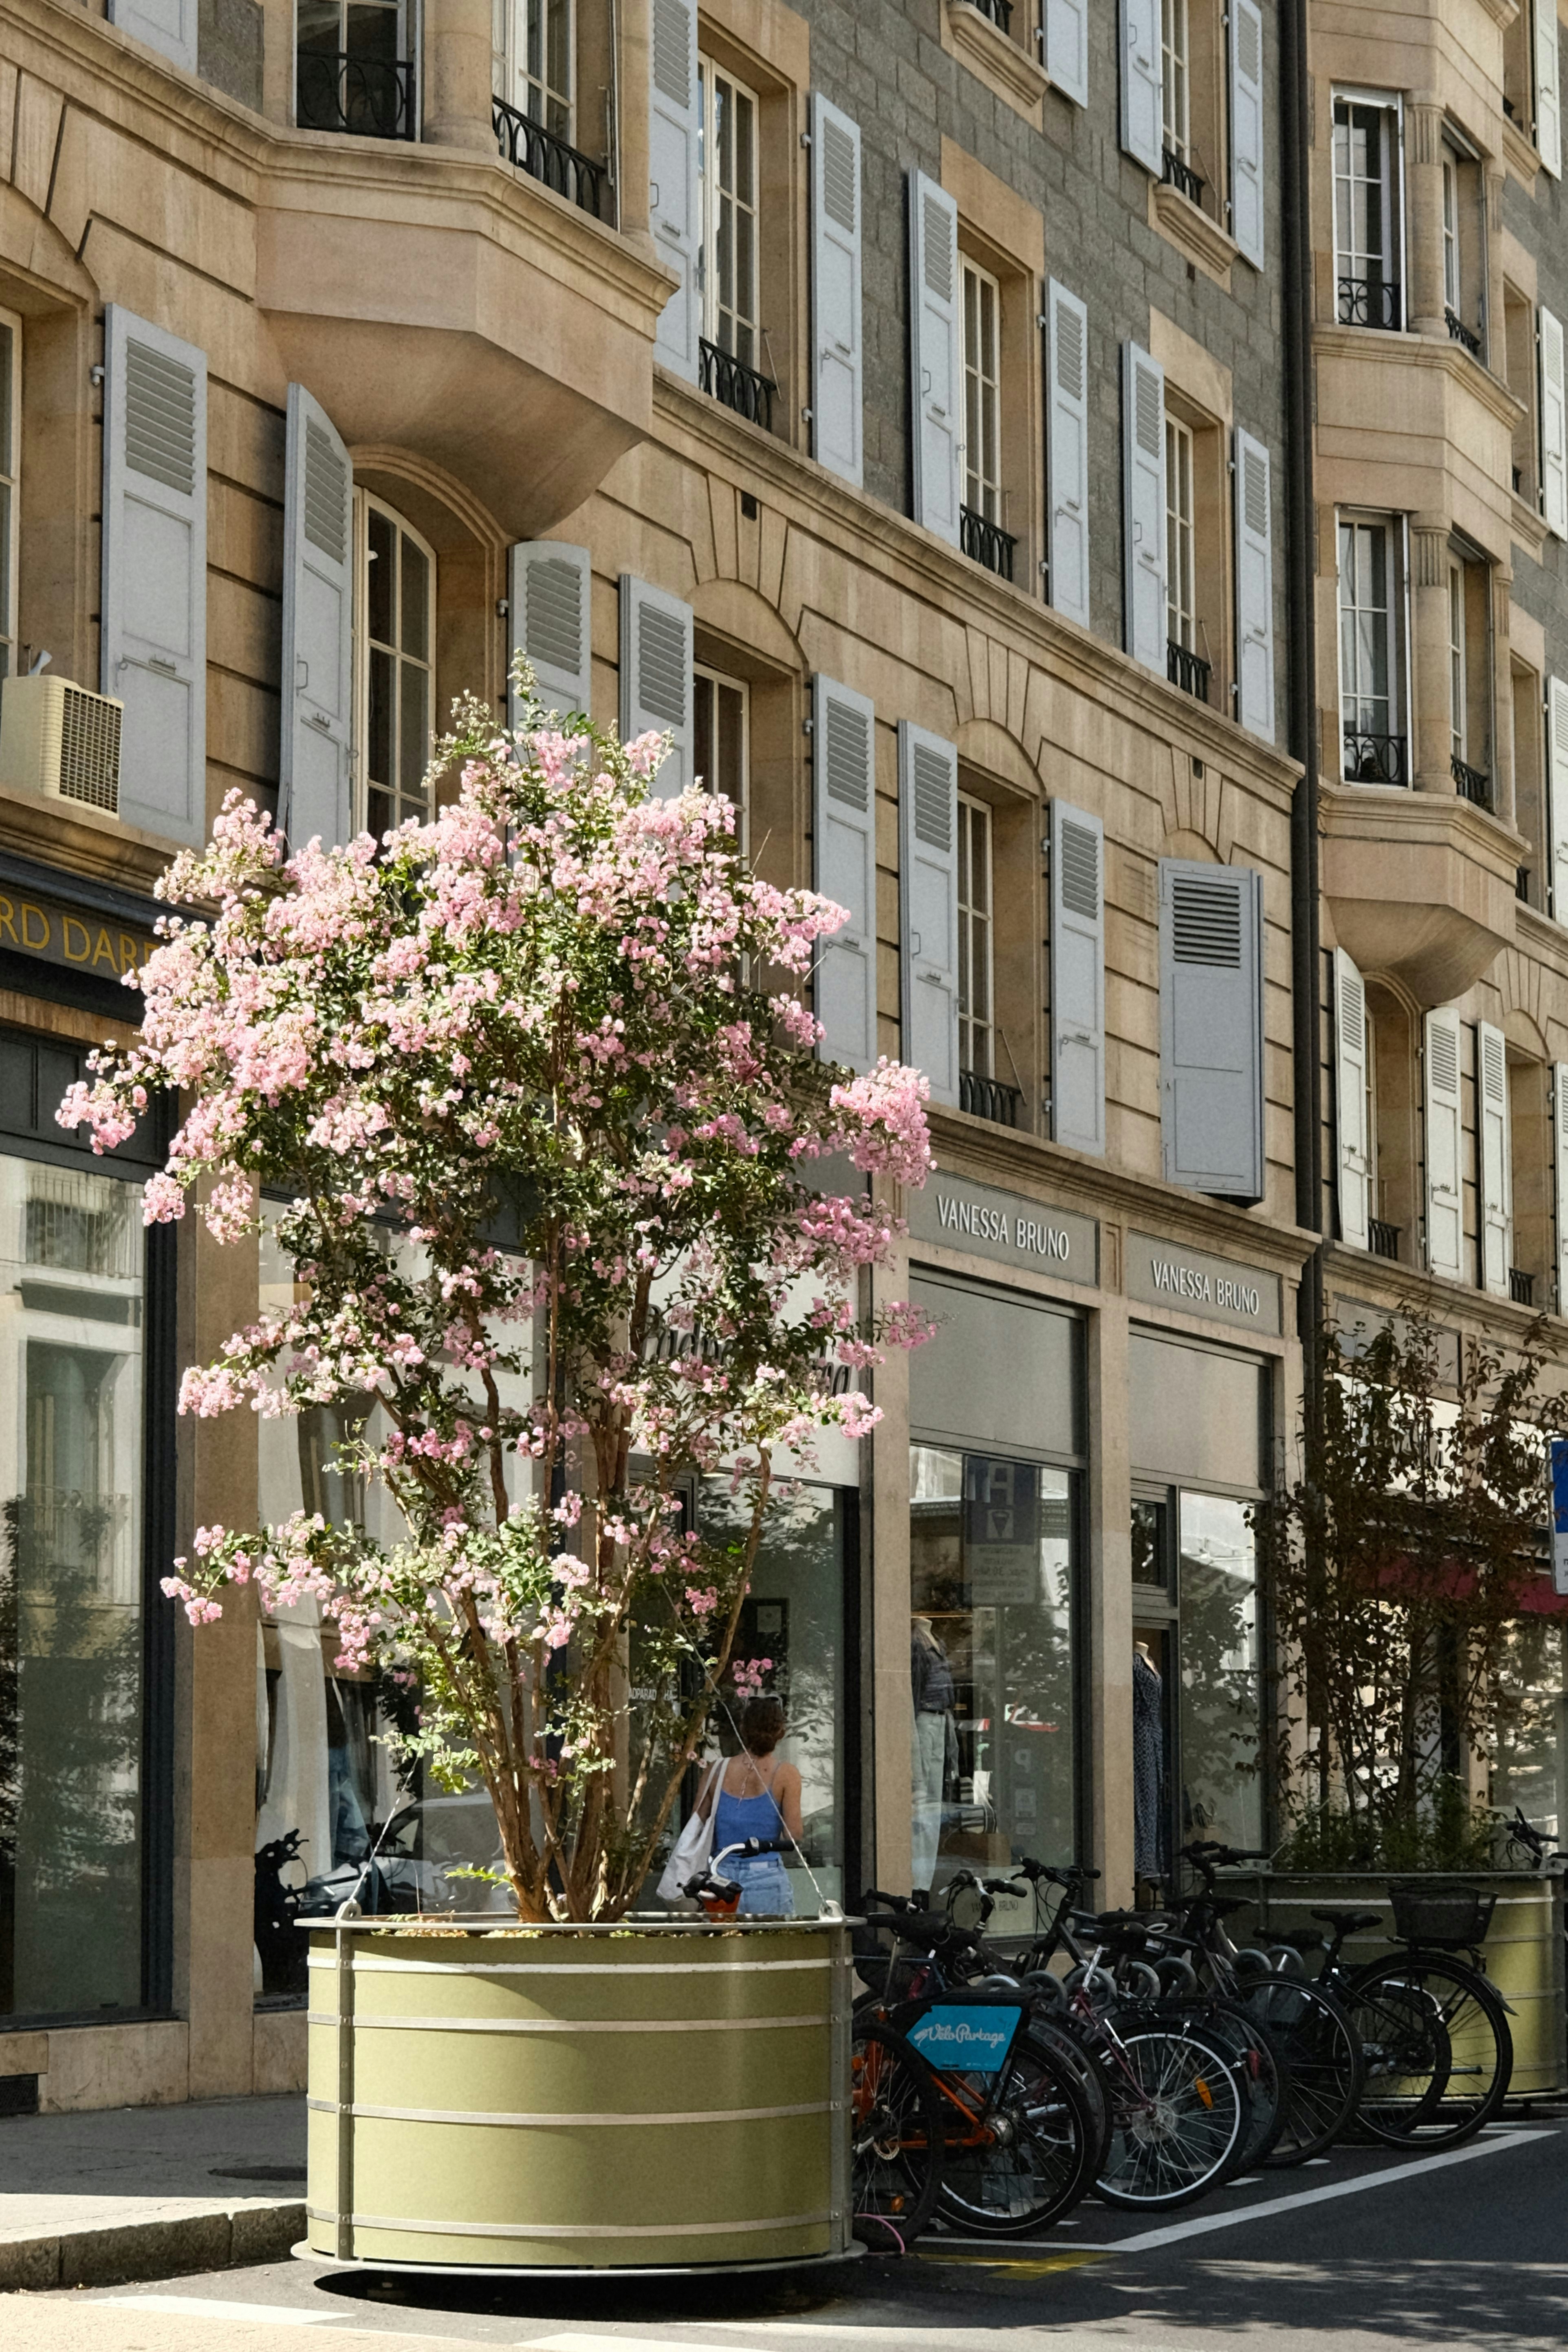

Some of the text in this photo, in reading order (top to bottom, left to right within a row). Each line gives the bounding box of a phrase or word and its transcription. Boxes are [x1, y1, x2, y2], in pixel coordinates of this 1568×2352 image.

[938, 1194, 1069, 1261] VANESSA BRUNO
[1152, 1259, 1260, 1315] VANESSA BRUNO
[998, 1900, 1018, 1911] BRUNO
